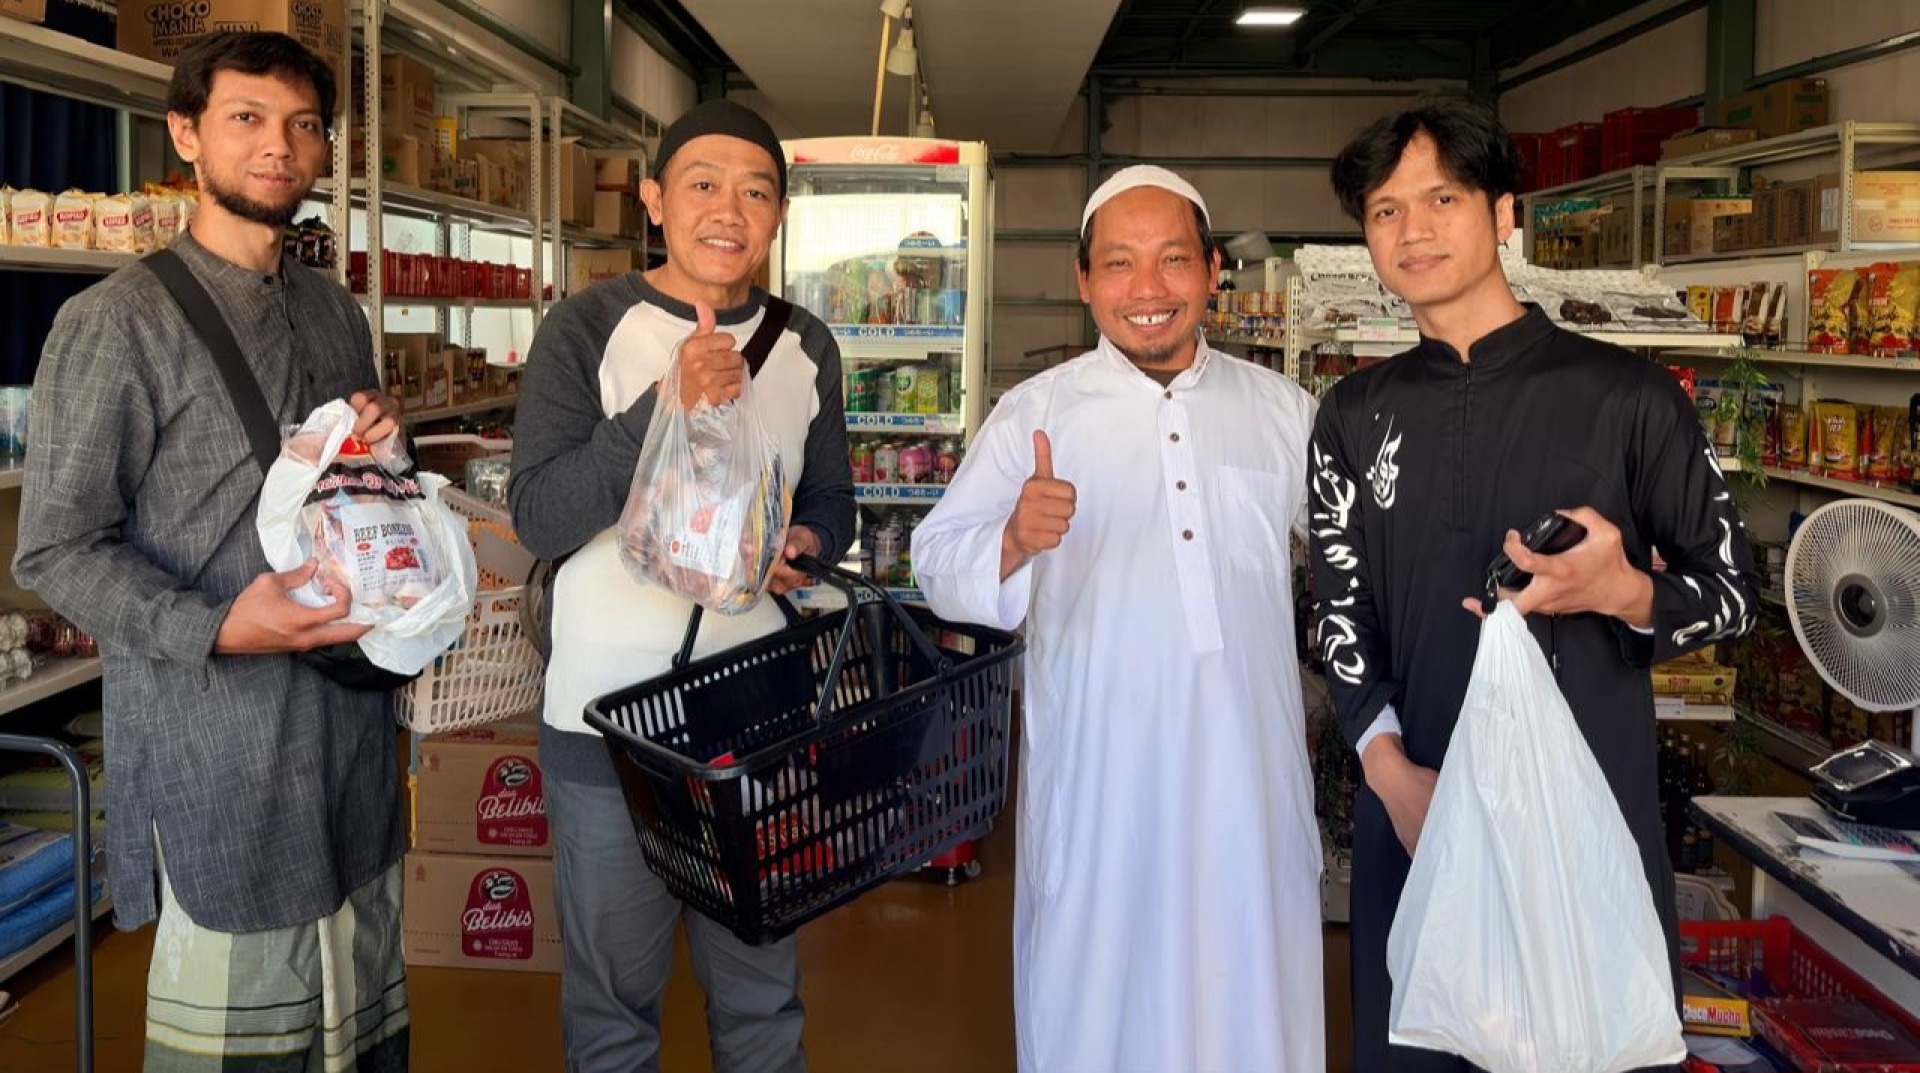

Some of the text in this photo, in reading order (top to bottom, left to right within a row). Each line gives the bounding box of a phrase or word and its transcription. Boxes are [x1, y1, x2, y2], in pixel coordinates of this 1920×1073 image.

[145, 0, 210, 23] CHOCO
[154, 18, 206, 36] MANIA
[859, 327, 895, 336] COLD
[857, 415, 894, 426] COLD
[863, 486, 900, 498] COLD
[354, 525, 378, 543] BEEF
[463, 907, 532, 932] Belibis
